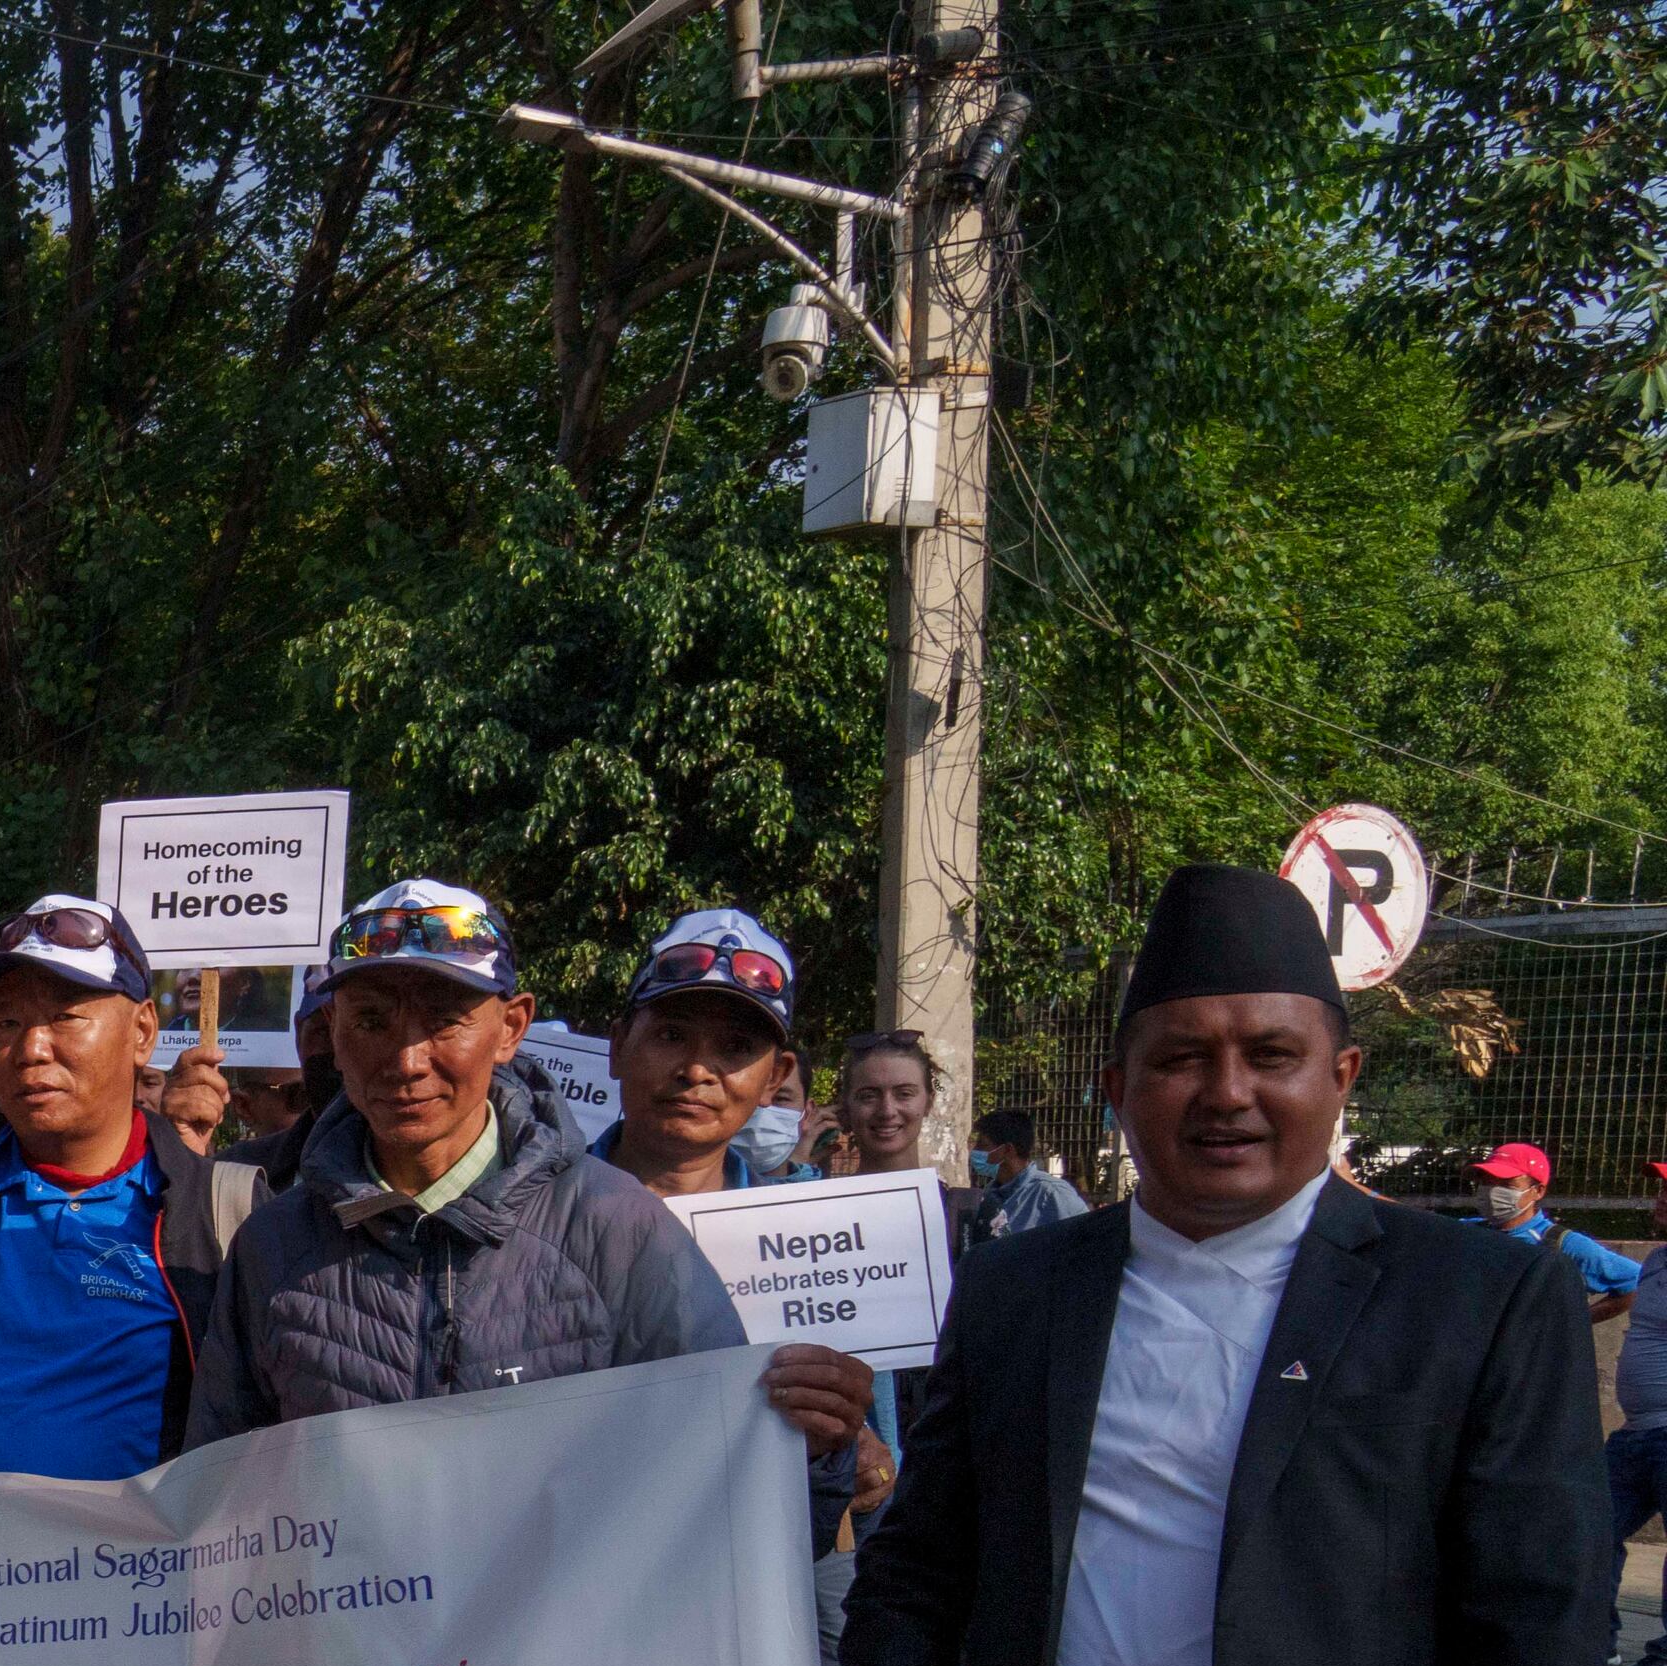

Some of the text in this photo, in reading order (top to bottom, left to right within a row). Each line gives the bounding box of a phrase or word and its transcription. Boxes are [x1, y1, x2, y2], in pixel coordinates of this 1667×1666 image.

[143, 836, 302, 860] Homecoming
[187, 864, 253, 885] of the
[151, 891, 288, 920] Heroes
[1327, 849, 1394, 956] P
[162, 1035, 242, 1048] Lhakpa erpa
[547, 1058, 573, 1073] the
[758, 1222, 865, 1263] Nepal
[80, 1274, 130, 1289] BRIGA
[87, 1286, 144, 1302] GURKHAS
[724, 1261, 908, 1298] celebrates your
[782, 1297, 857, 1328] Rise
[93, 1526, 264, 1590] Sagarmatha
[272, 1515, 339, 1558] Day
[122, 1598, 222, 1637] Jubilee
[231, 1574, 434, 1626] Celebration
